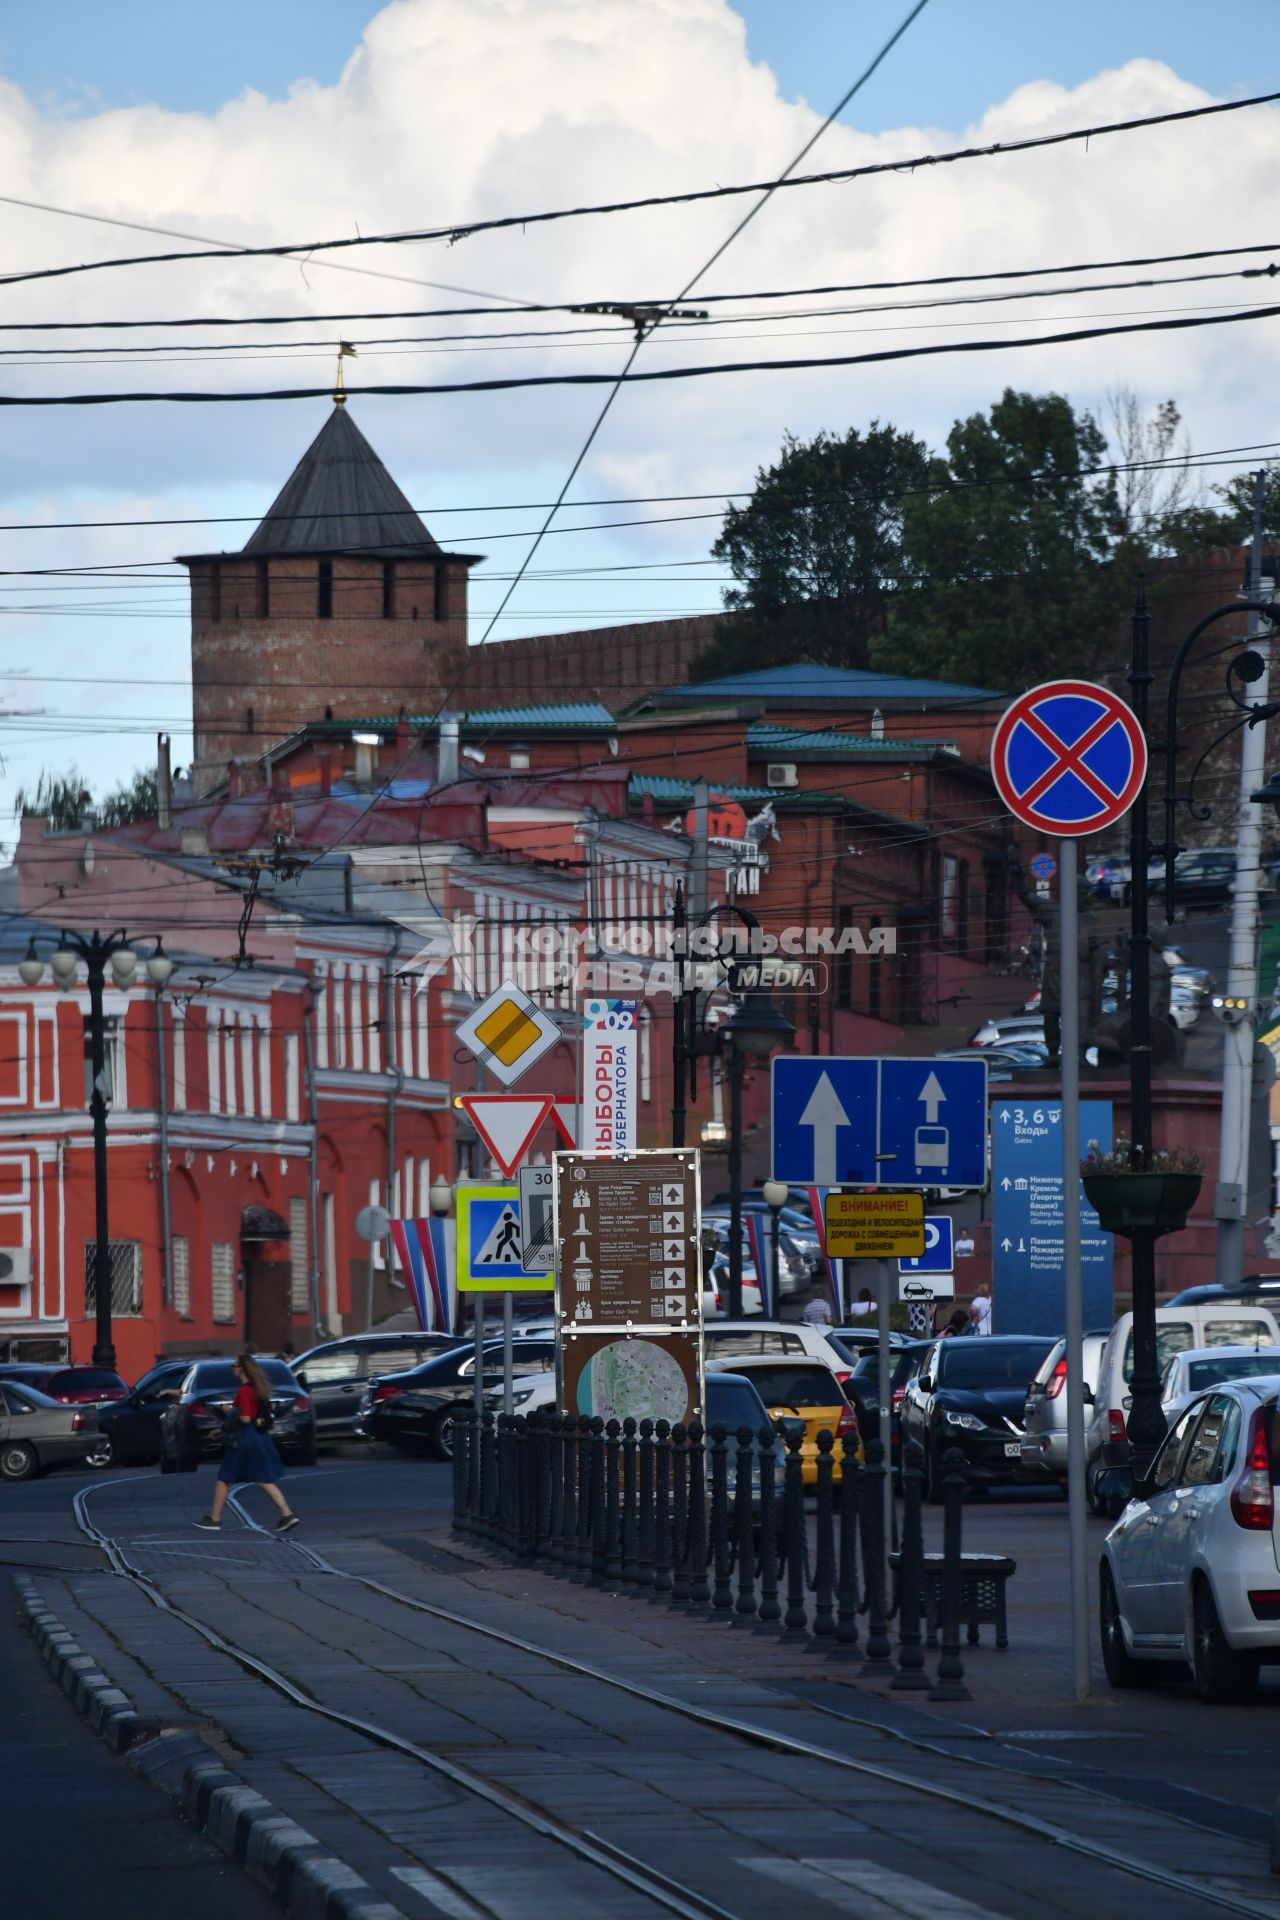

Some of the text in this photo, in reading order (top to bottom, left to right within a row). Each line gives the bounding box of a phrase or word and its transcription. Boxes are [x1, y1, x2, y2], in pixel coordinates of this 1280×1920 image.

[1033, 1109, 1044, 1124] 6
[1014, 1126, 1048, 1136] Входы
[840, 1200, 908, 1212] ВНИМАНИЕ!
